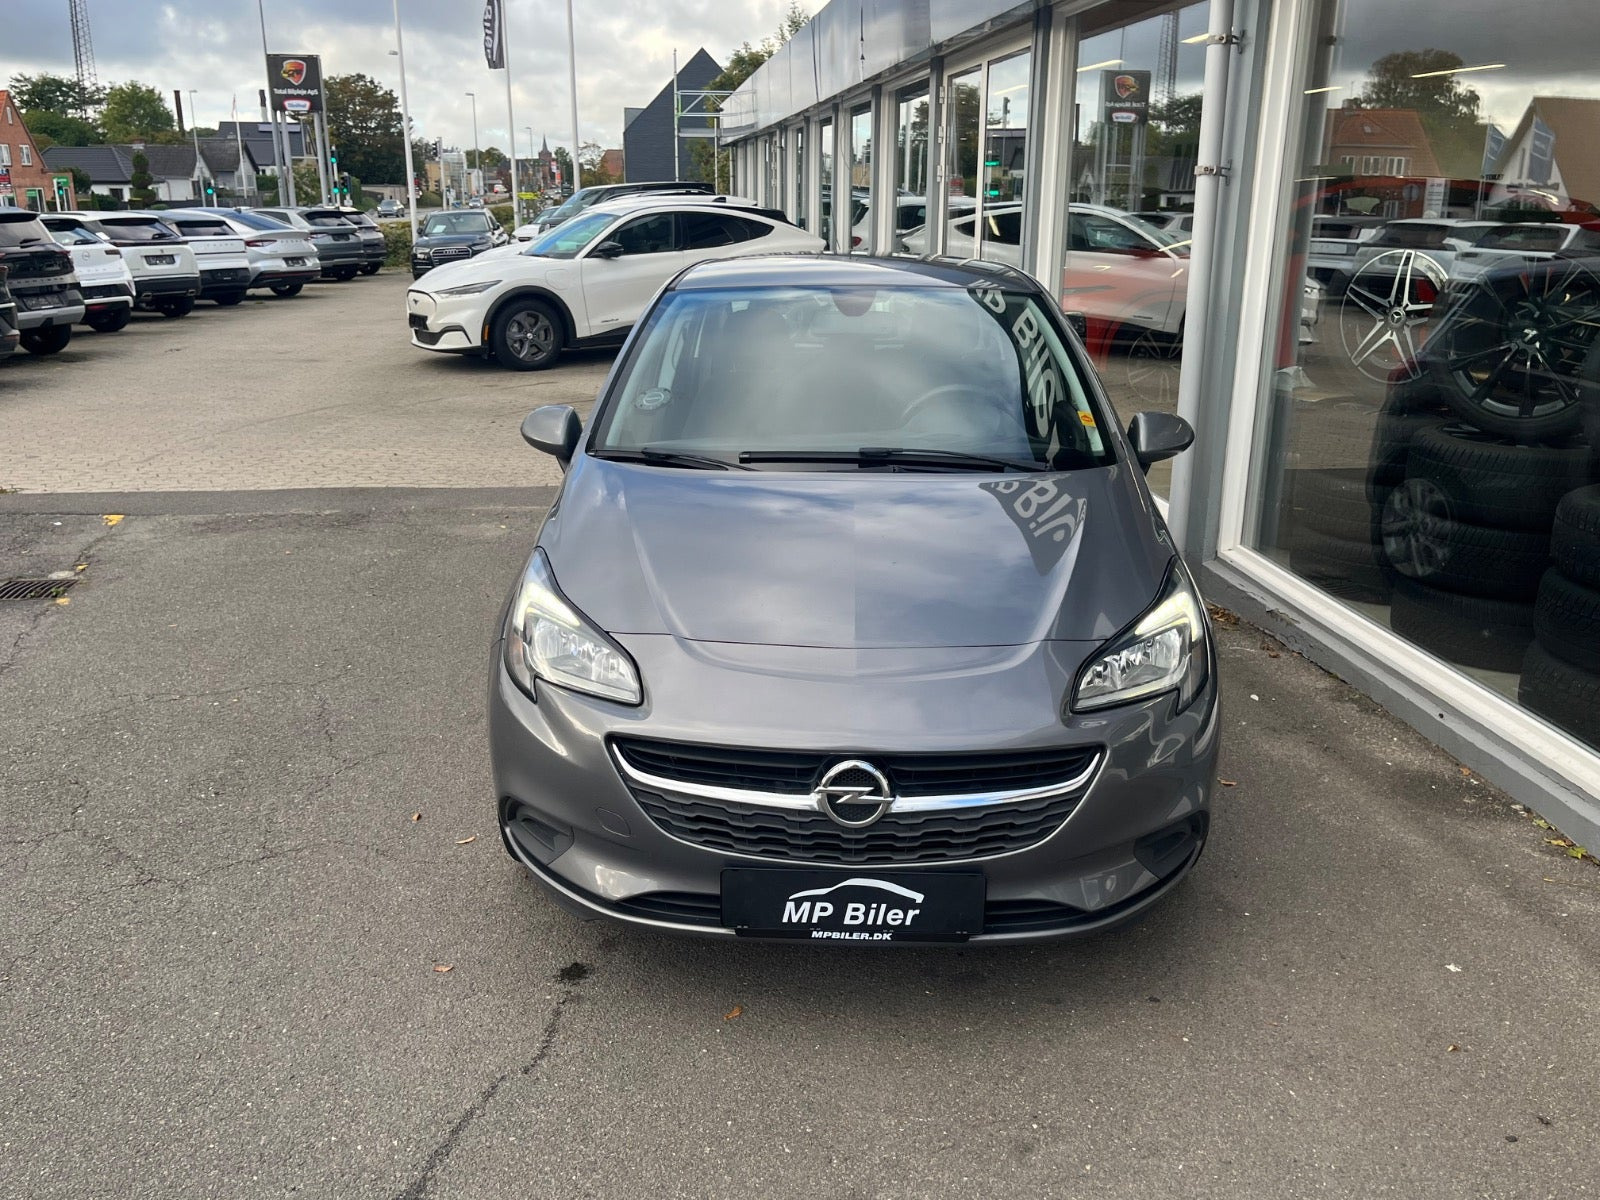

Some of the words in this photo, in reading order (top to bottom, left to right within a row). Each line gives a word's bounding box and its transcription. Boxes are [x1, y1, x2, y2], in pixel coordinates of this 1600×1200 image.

[782, 901, 834, 923] MP
[842, 903, 920, 925] Biler
[812, 931, 893, 941] MPBILER.DK
